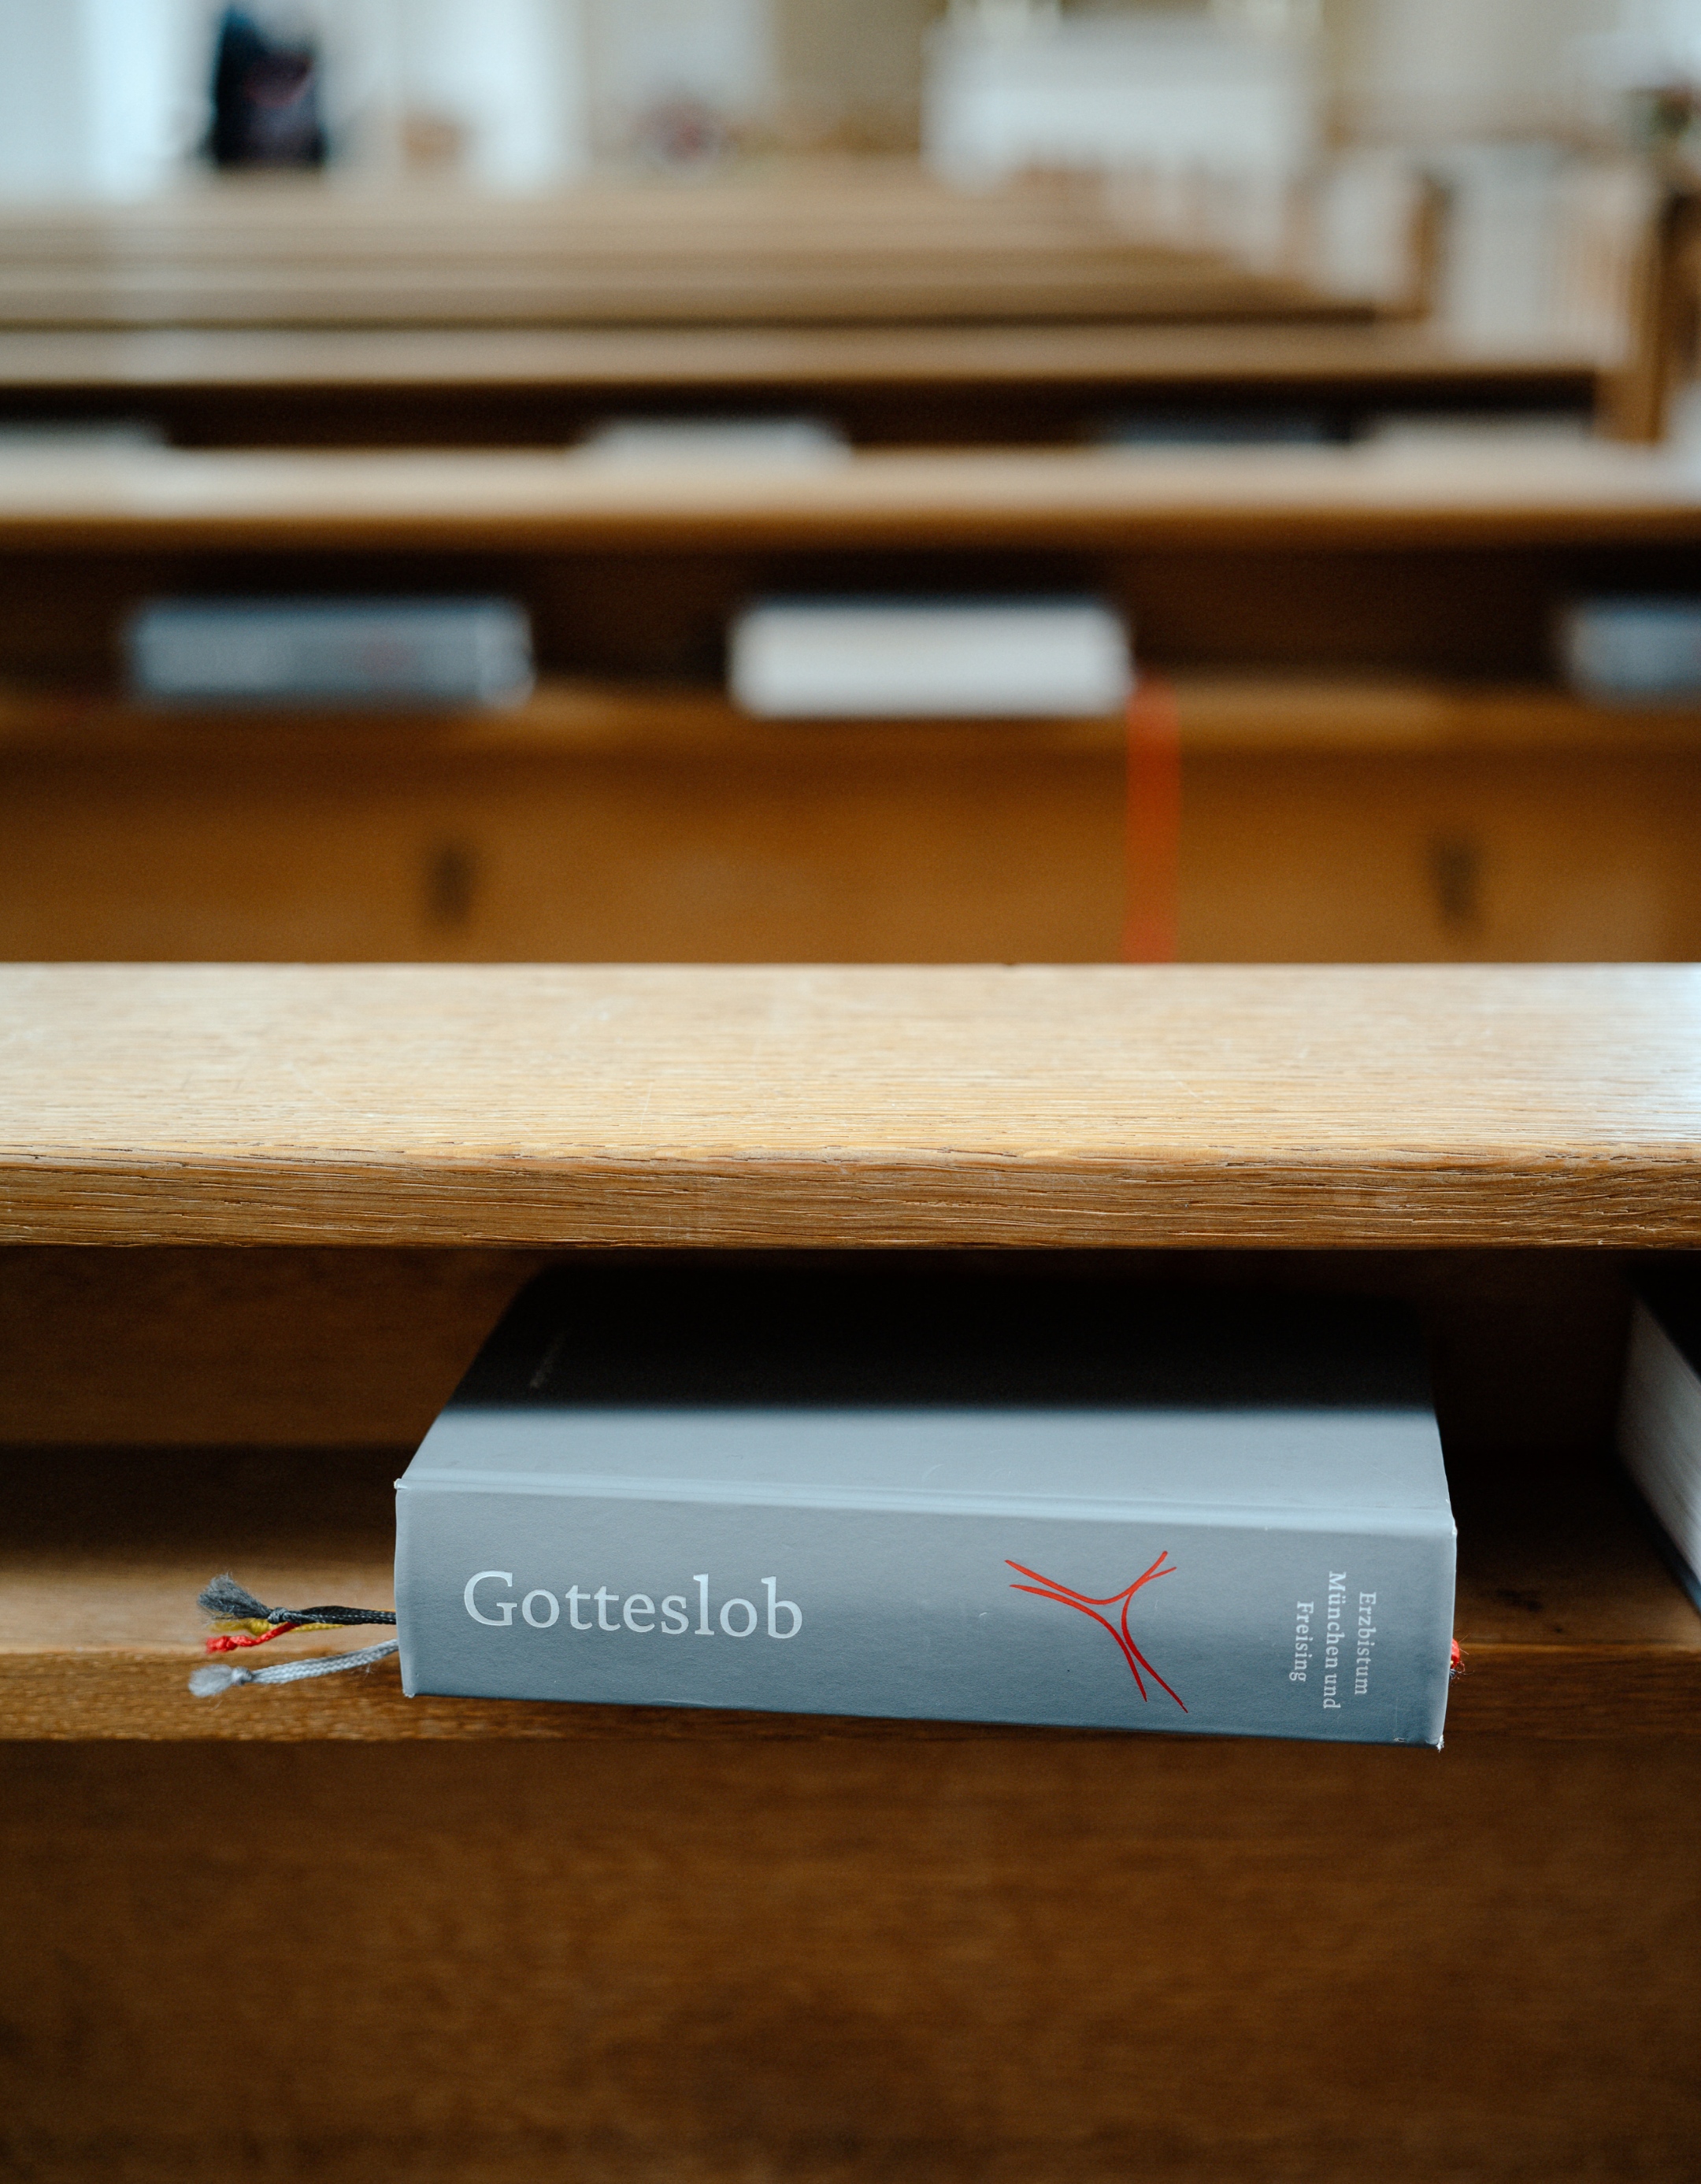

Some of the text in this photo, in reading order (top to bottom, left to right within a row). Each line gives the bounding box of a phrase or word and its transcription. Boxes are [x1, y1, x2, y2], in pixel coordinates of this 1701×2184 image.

[464, 1570, 802, 1639] Gotteslob
[1288, 1601, 1314, 1682] Freising
[1323, 1571, 1347, 1708] München und
[1354, 1592, 1377, 1695] Erzbistum
